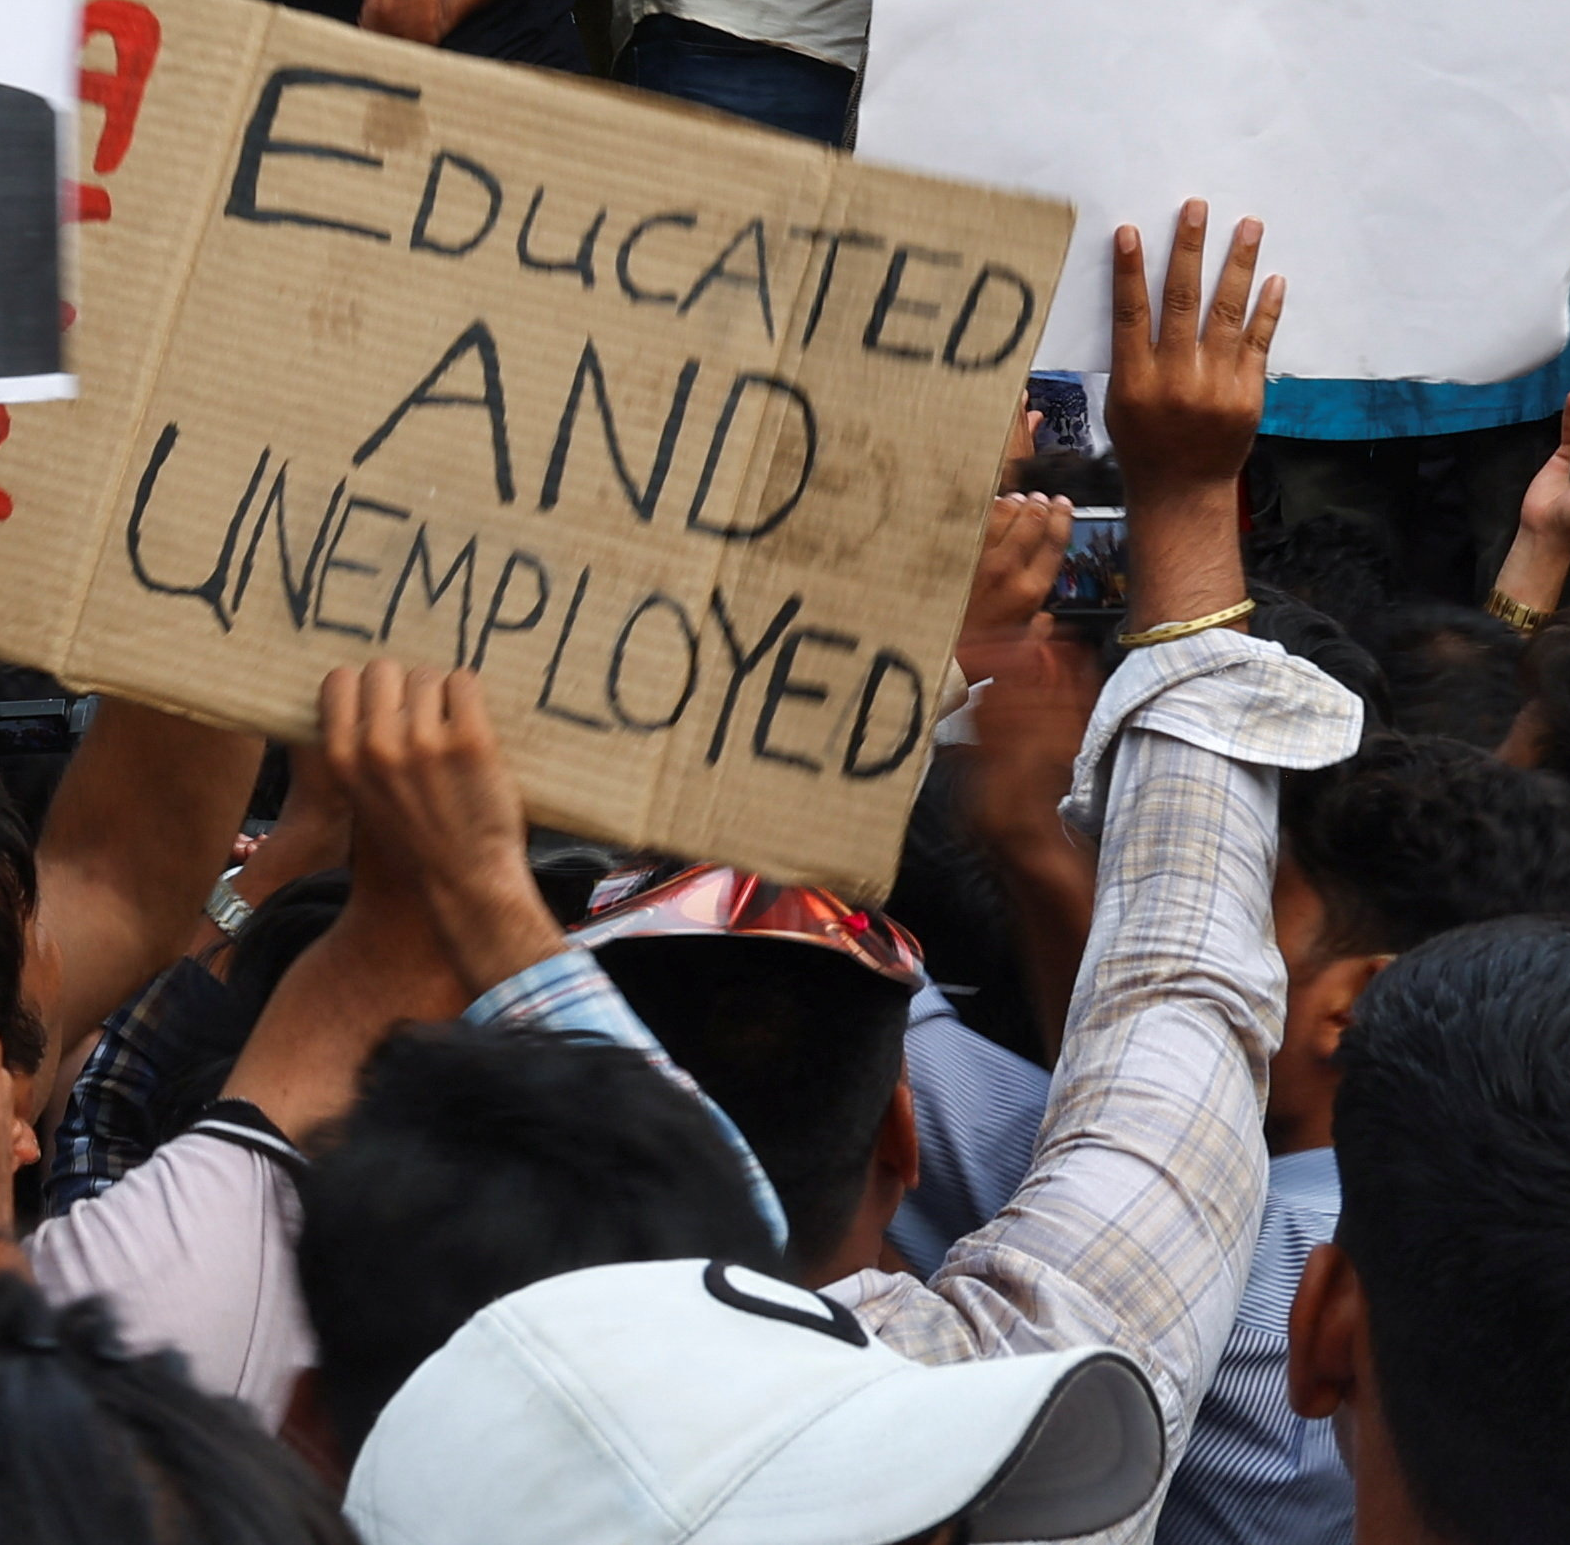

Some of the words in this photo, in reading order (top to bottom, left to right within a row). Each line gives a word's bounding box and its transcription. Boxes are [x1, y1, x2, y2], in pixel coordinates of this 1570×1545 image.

[225, 64, 1036, 374] EDUCATED
[353, 319, 818, 543] AND
[125, 422, 926, 781] UNEMPLOYED
